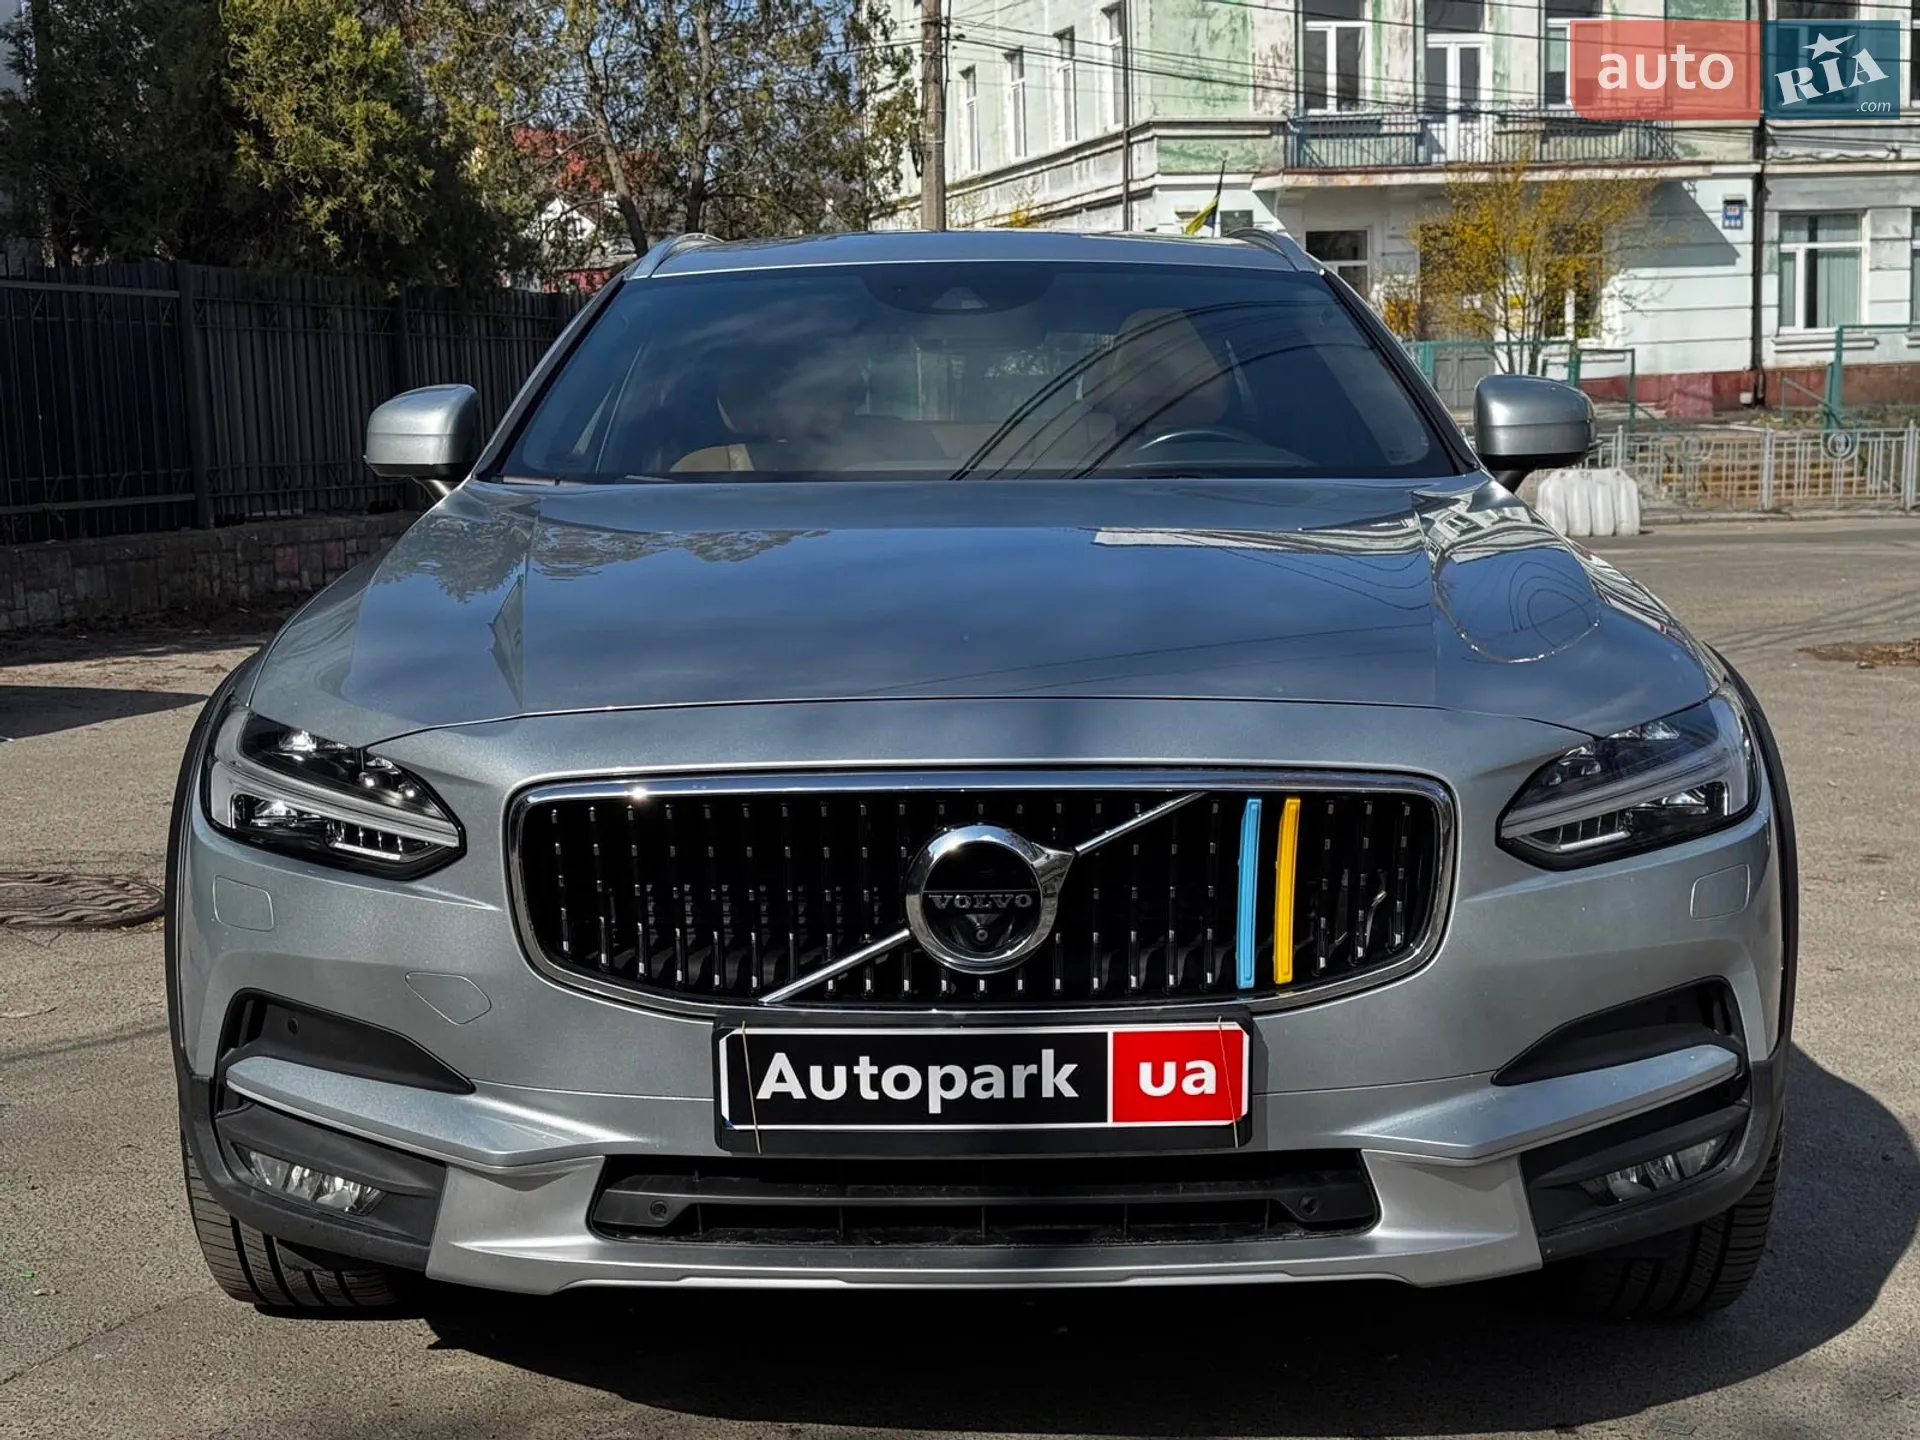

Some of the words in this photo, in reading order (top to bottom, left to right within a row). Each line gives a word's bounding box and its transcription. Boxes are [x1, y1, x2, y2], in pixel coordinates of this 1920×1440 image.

[928, 894, 1032, 909] VOLVO
[756, 1049, 1079, 1114] Autopark
[1138, 1059, 1217, 1096] ua
